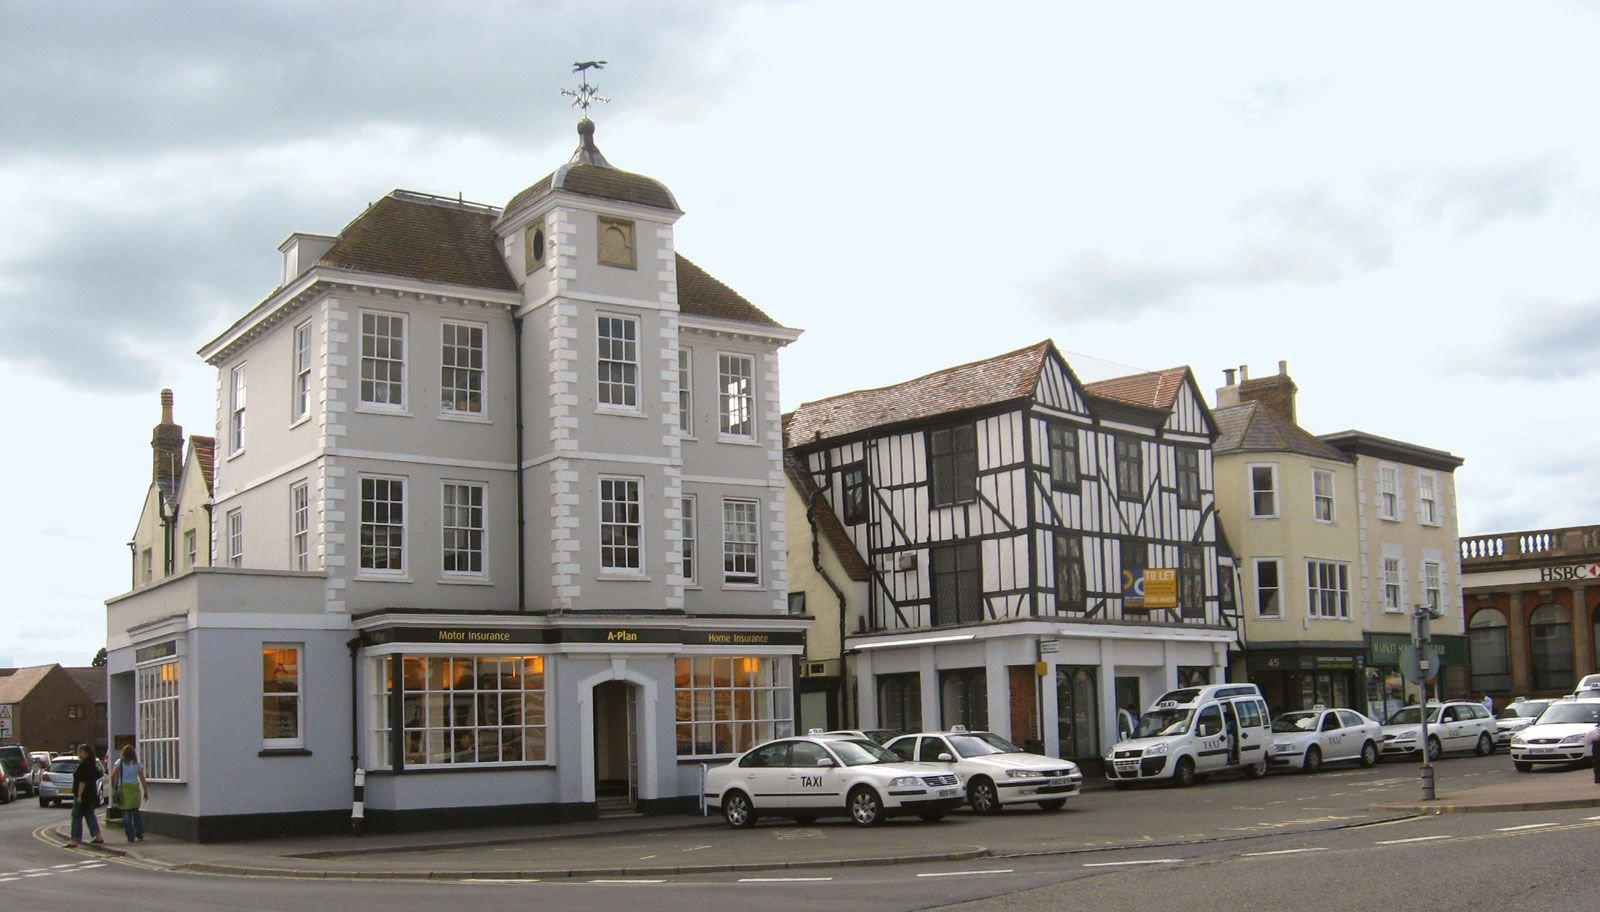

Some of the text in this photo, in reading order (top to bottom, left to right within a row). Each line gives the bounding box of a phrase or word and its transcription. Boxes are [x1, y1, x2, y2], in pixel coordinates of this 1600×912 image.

[1146, 571, 1175, 580] TO LET
[1540, 565, 1587, 581] HSBC
[438, 631, 510, 641] Motor Insurance
[607, 630, 637, 641] A-Plan
[708, 633, 769, 643] Home Insurance
[1268, 658, 1280, 667] 45
[1202, 740, 1220, 749] TAXI
[801, 776, 823, 787] TAXI
